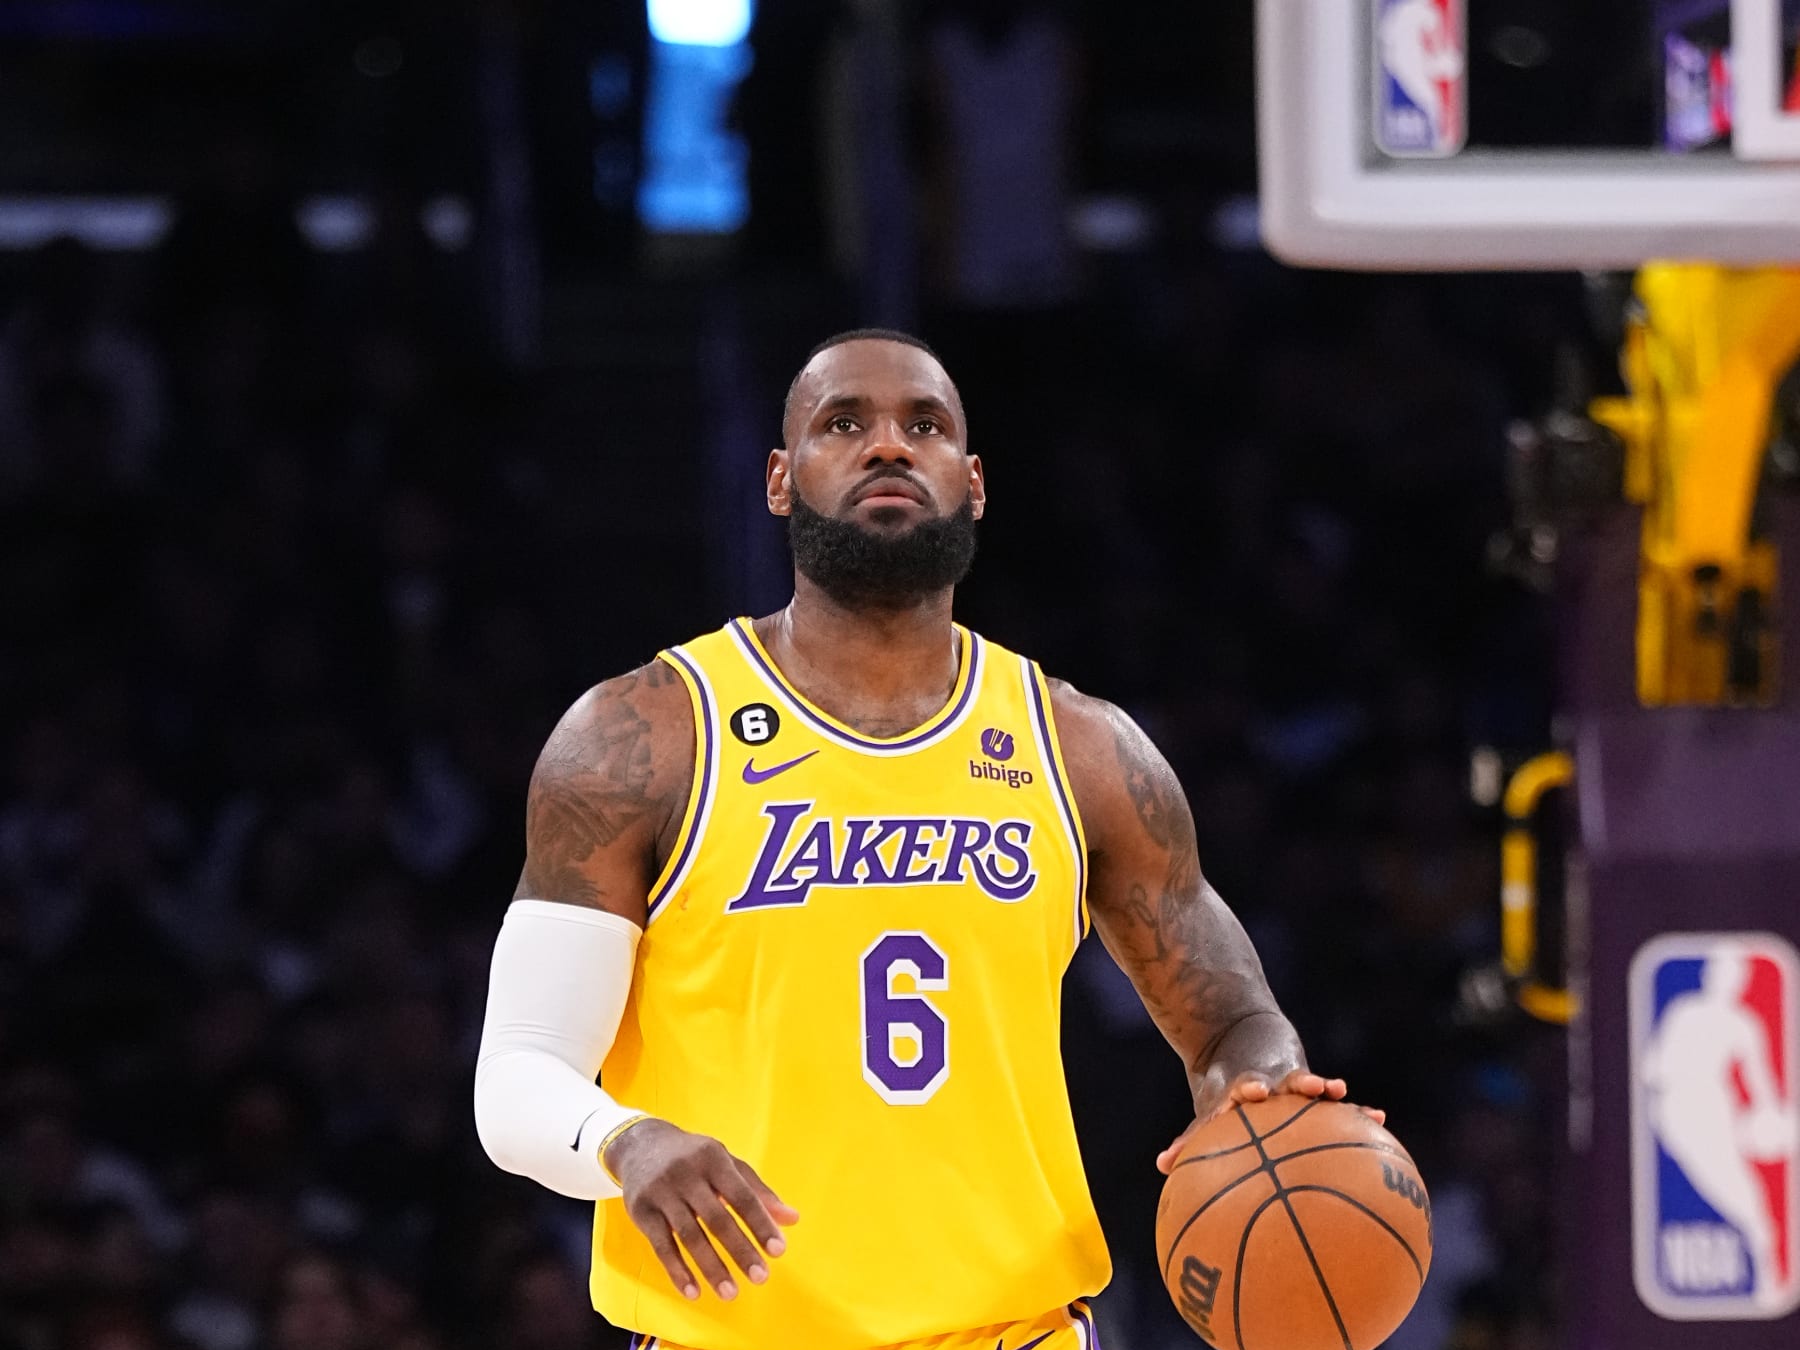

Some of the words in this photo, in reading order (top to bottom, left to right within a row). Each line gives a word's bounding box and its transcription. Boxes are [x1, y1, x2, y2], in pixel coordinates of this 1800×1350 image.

[740, 708, 769, 742] 6
[969, 760, 1033, 788] bibigo
[725, 799, 1038, 912] LAKERS
[859, 931, 949, 1105] 6
